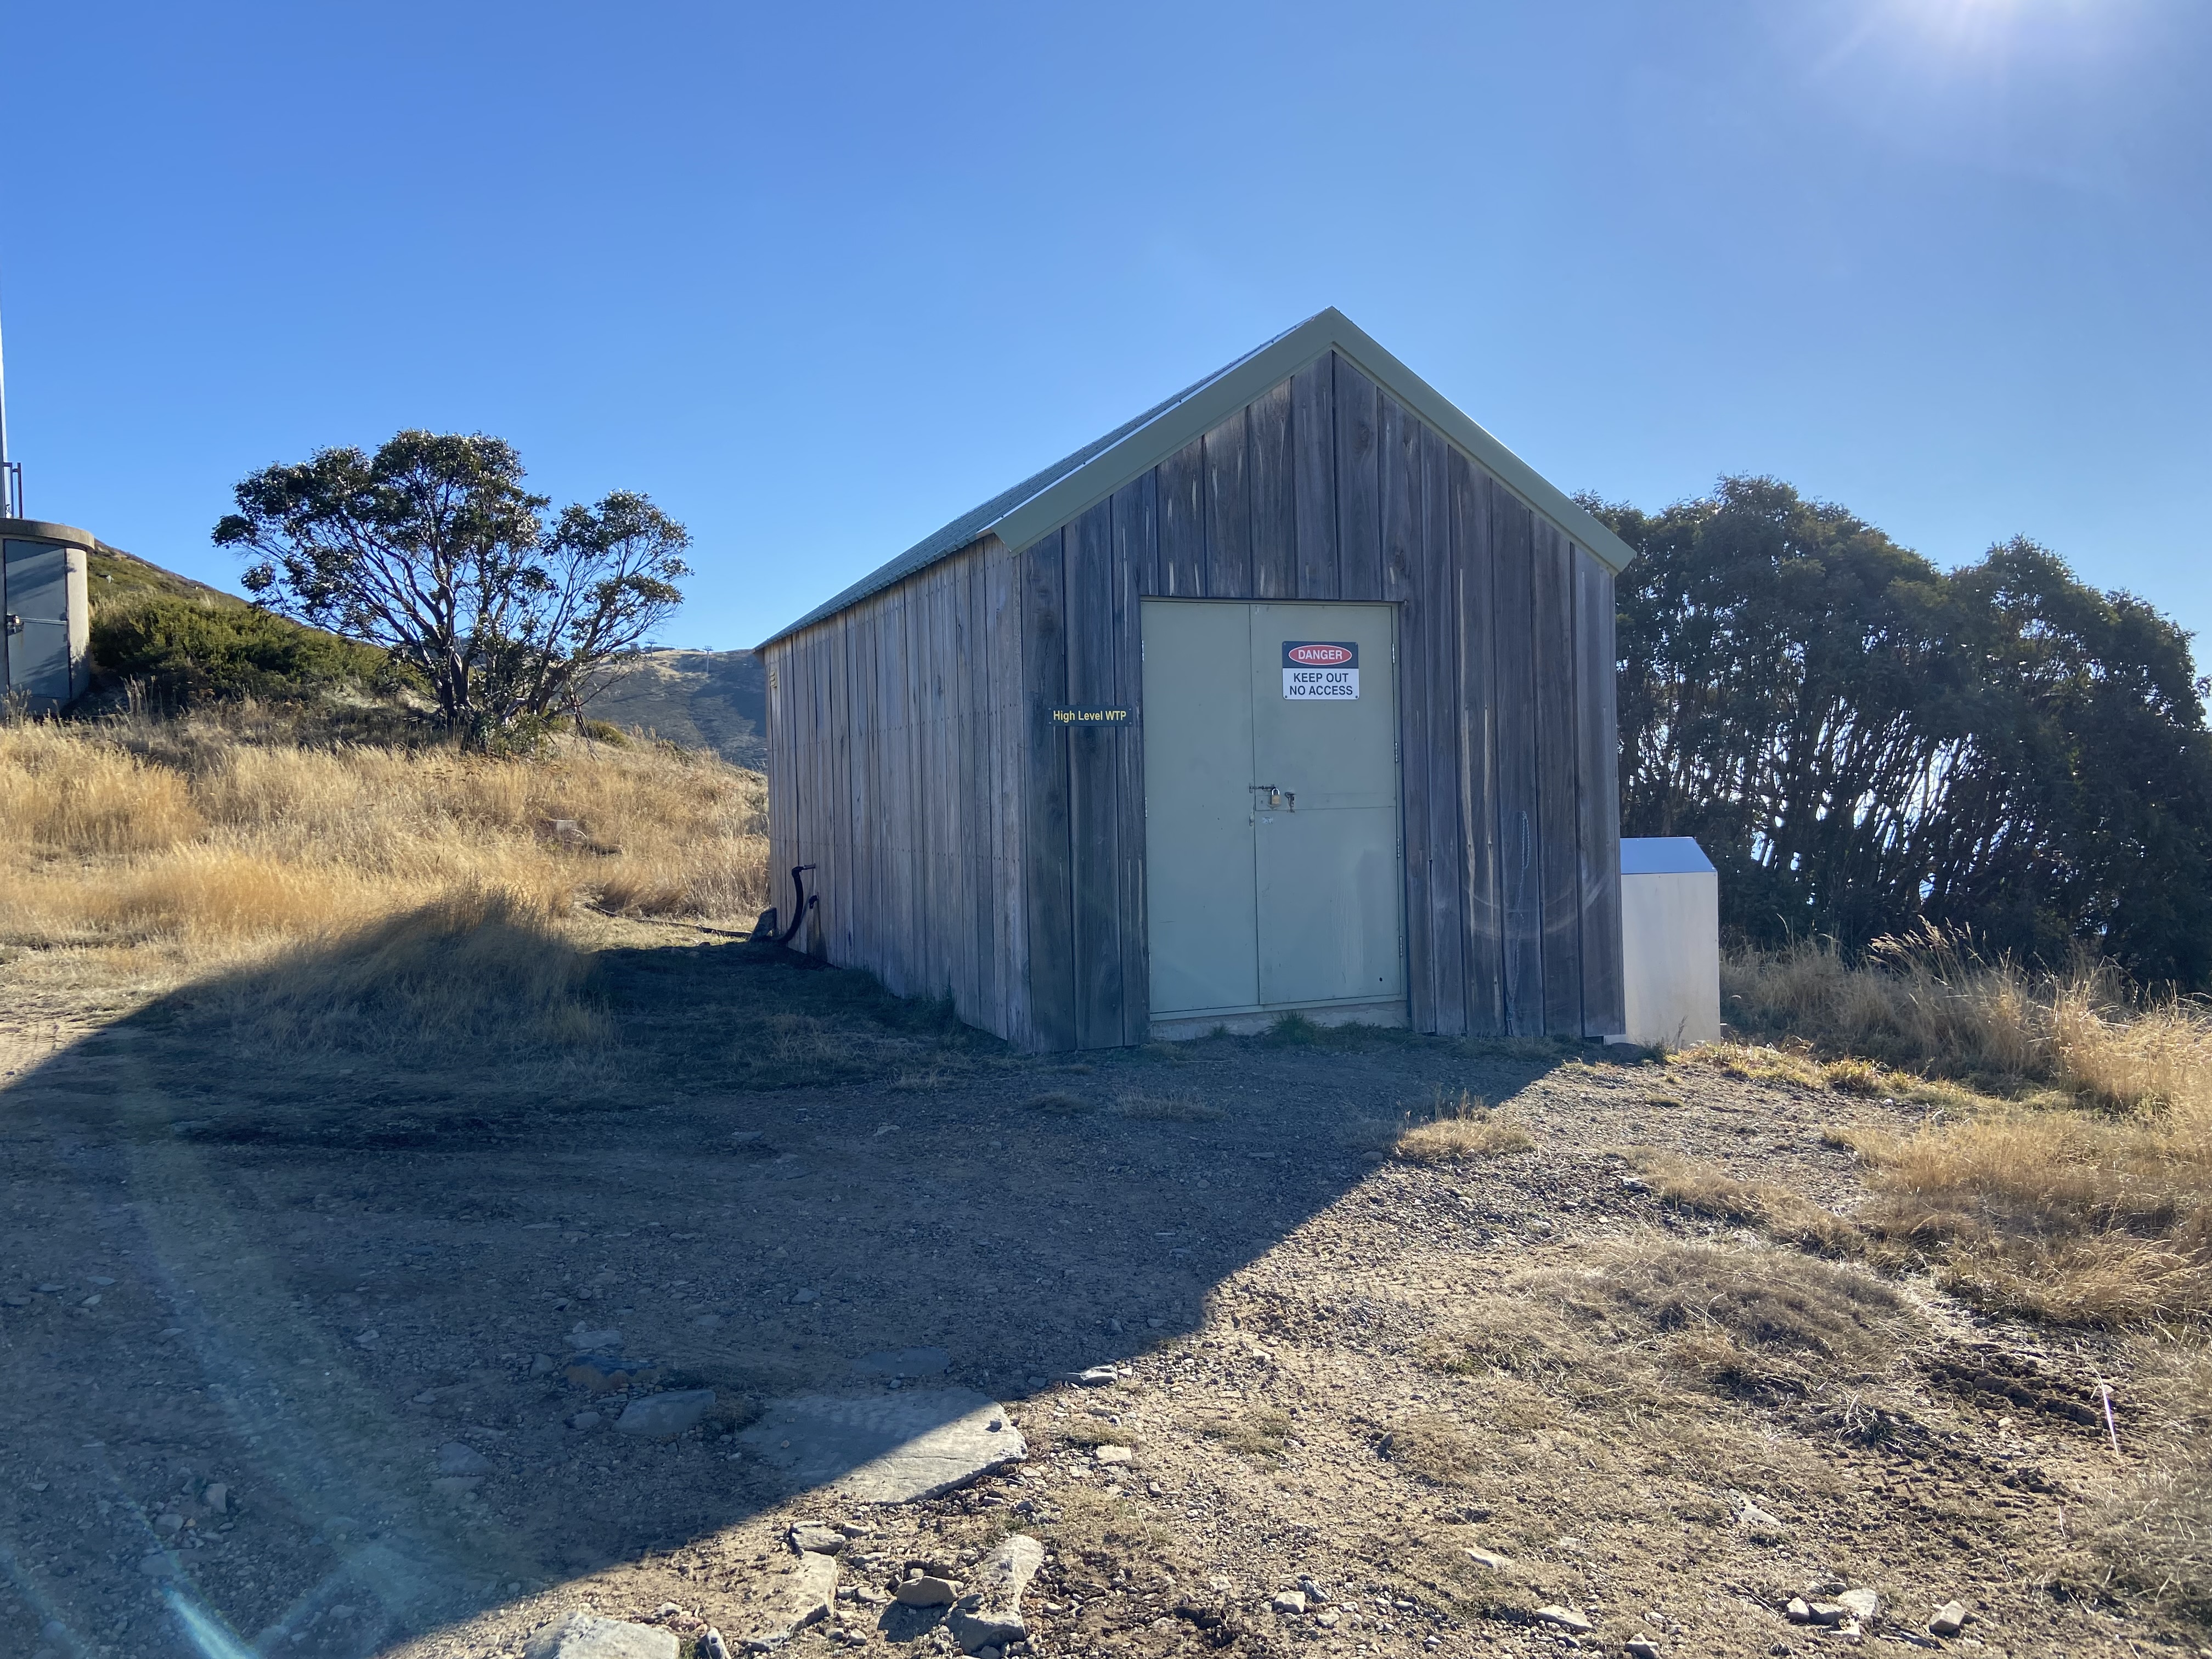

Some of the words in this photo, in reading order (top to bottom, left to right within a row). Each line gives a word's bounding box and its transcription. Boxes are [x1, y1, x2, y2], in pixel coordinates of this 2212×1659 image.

[1298, 650, 1342, 660] DANGER
[1294, 673, 1323, 682] KEEP
[1326, 673, 1348, 682] OUT
[1290, 686, 1306, 695] NO
[1309, 686, 1353, 695] ACCESS
[1053, 710, 1075, 723] High
[1078, 710, 1103, 720] Level
[1105, 710, 1126, 720] WTP
